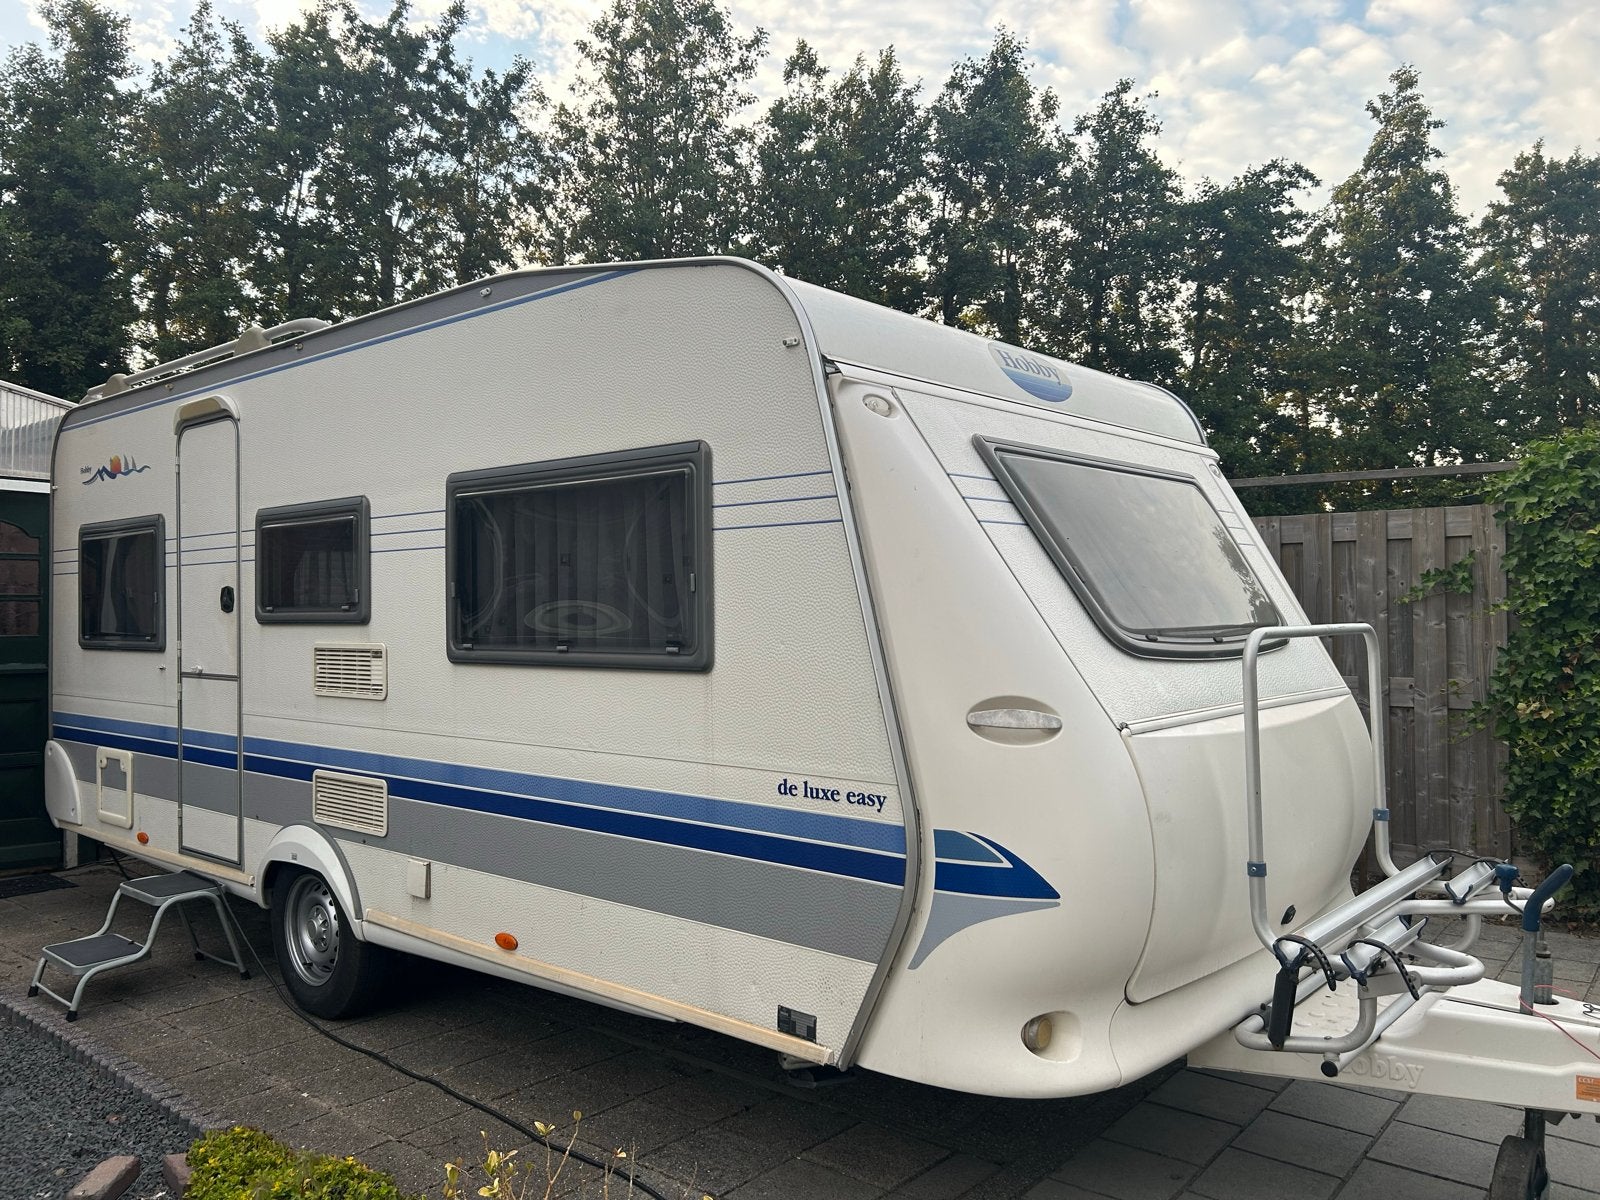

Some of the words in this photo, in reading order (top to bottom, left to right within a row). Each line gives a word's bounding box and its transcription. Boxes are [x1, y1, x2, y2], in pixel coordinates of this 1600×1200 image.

[994, 348, 1061, 386] Hobby
[777, 778, 798, 796] de
[803, 780, 841, 802] luxe
[846, 790, 887, 813] easy
[1341, 1053, 1424, 1089] obby
